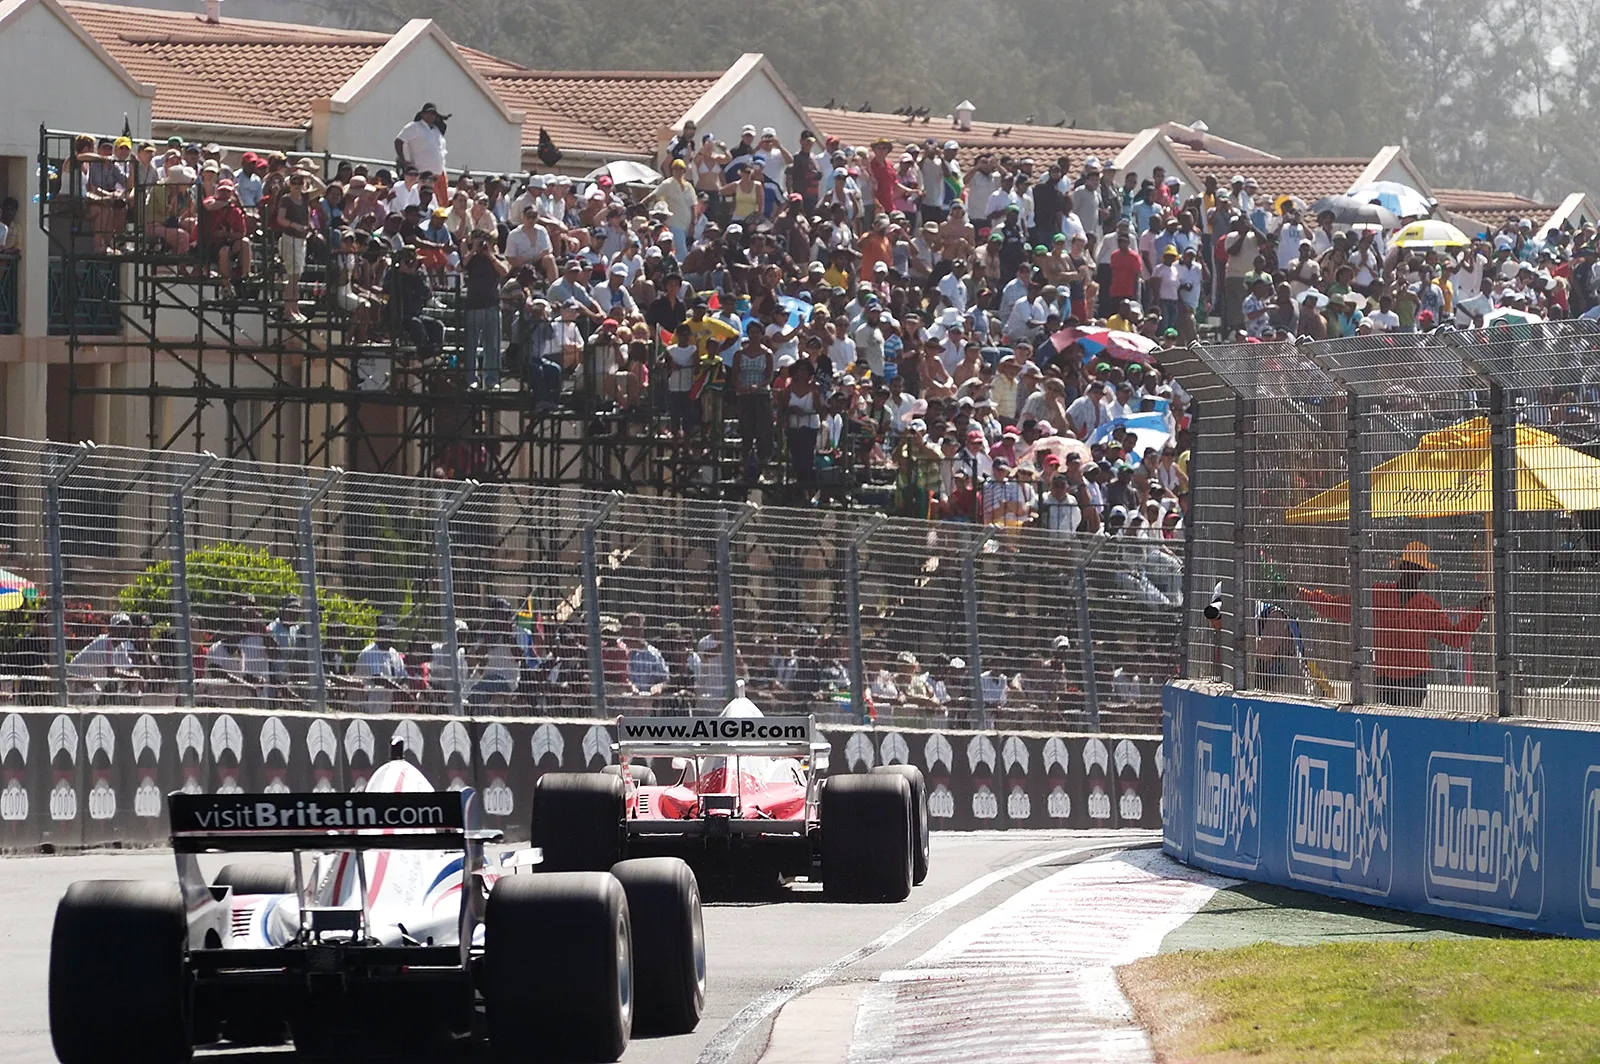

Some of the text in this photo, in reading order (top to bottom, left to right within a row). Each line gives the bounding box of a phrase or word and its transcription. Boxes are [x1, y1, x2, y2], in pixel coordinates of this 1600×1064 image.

[626, 720, 806, 738] www.A1GP.com
[195, 800, 443, 828] visitBritain.com
[1295, 755, 1354, 852] Durban
[1434, 773, 1502, 875] Durban
